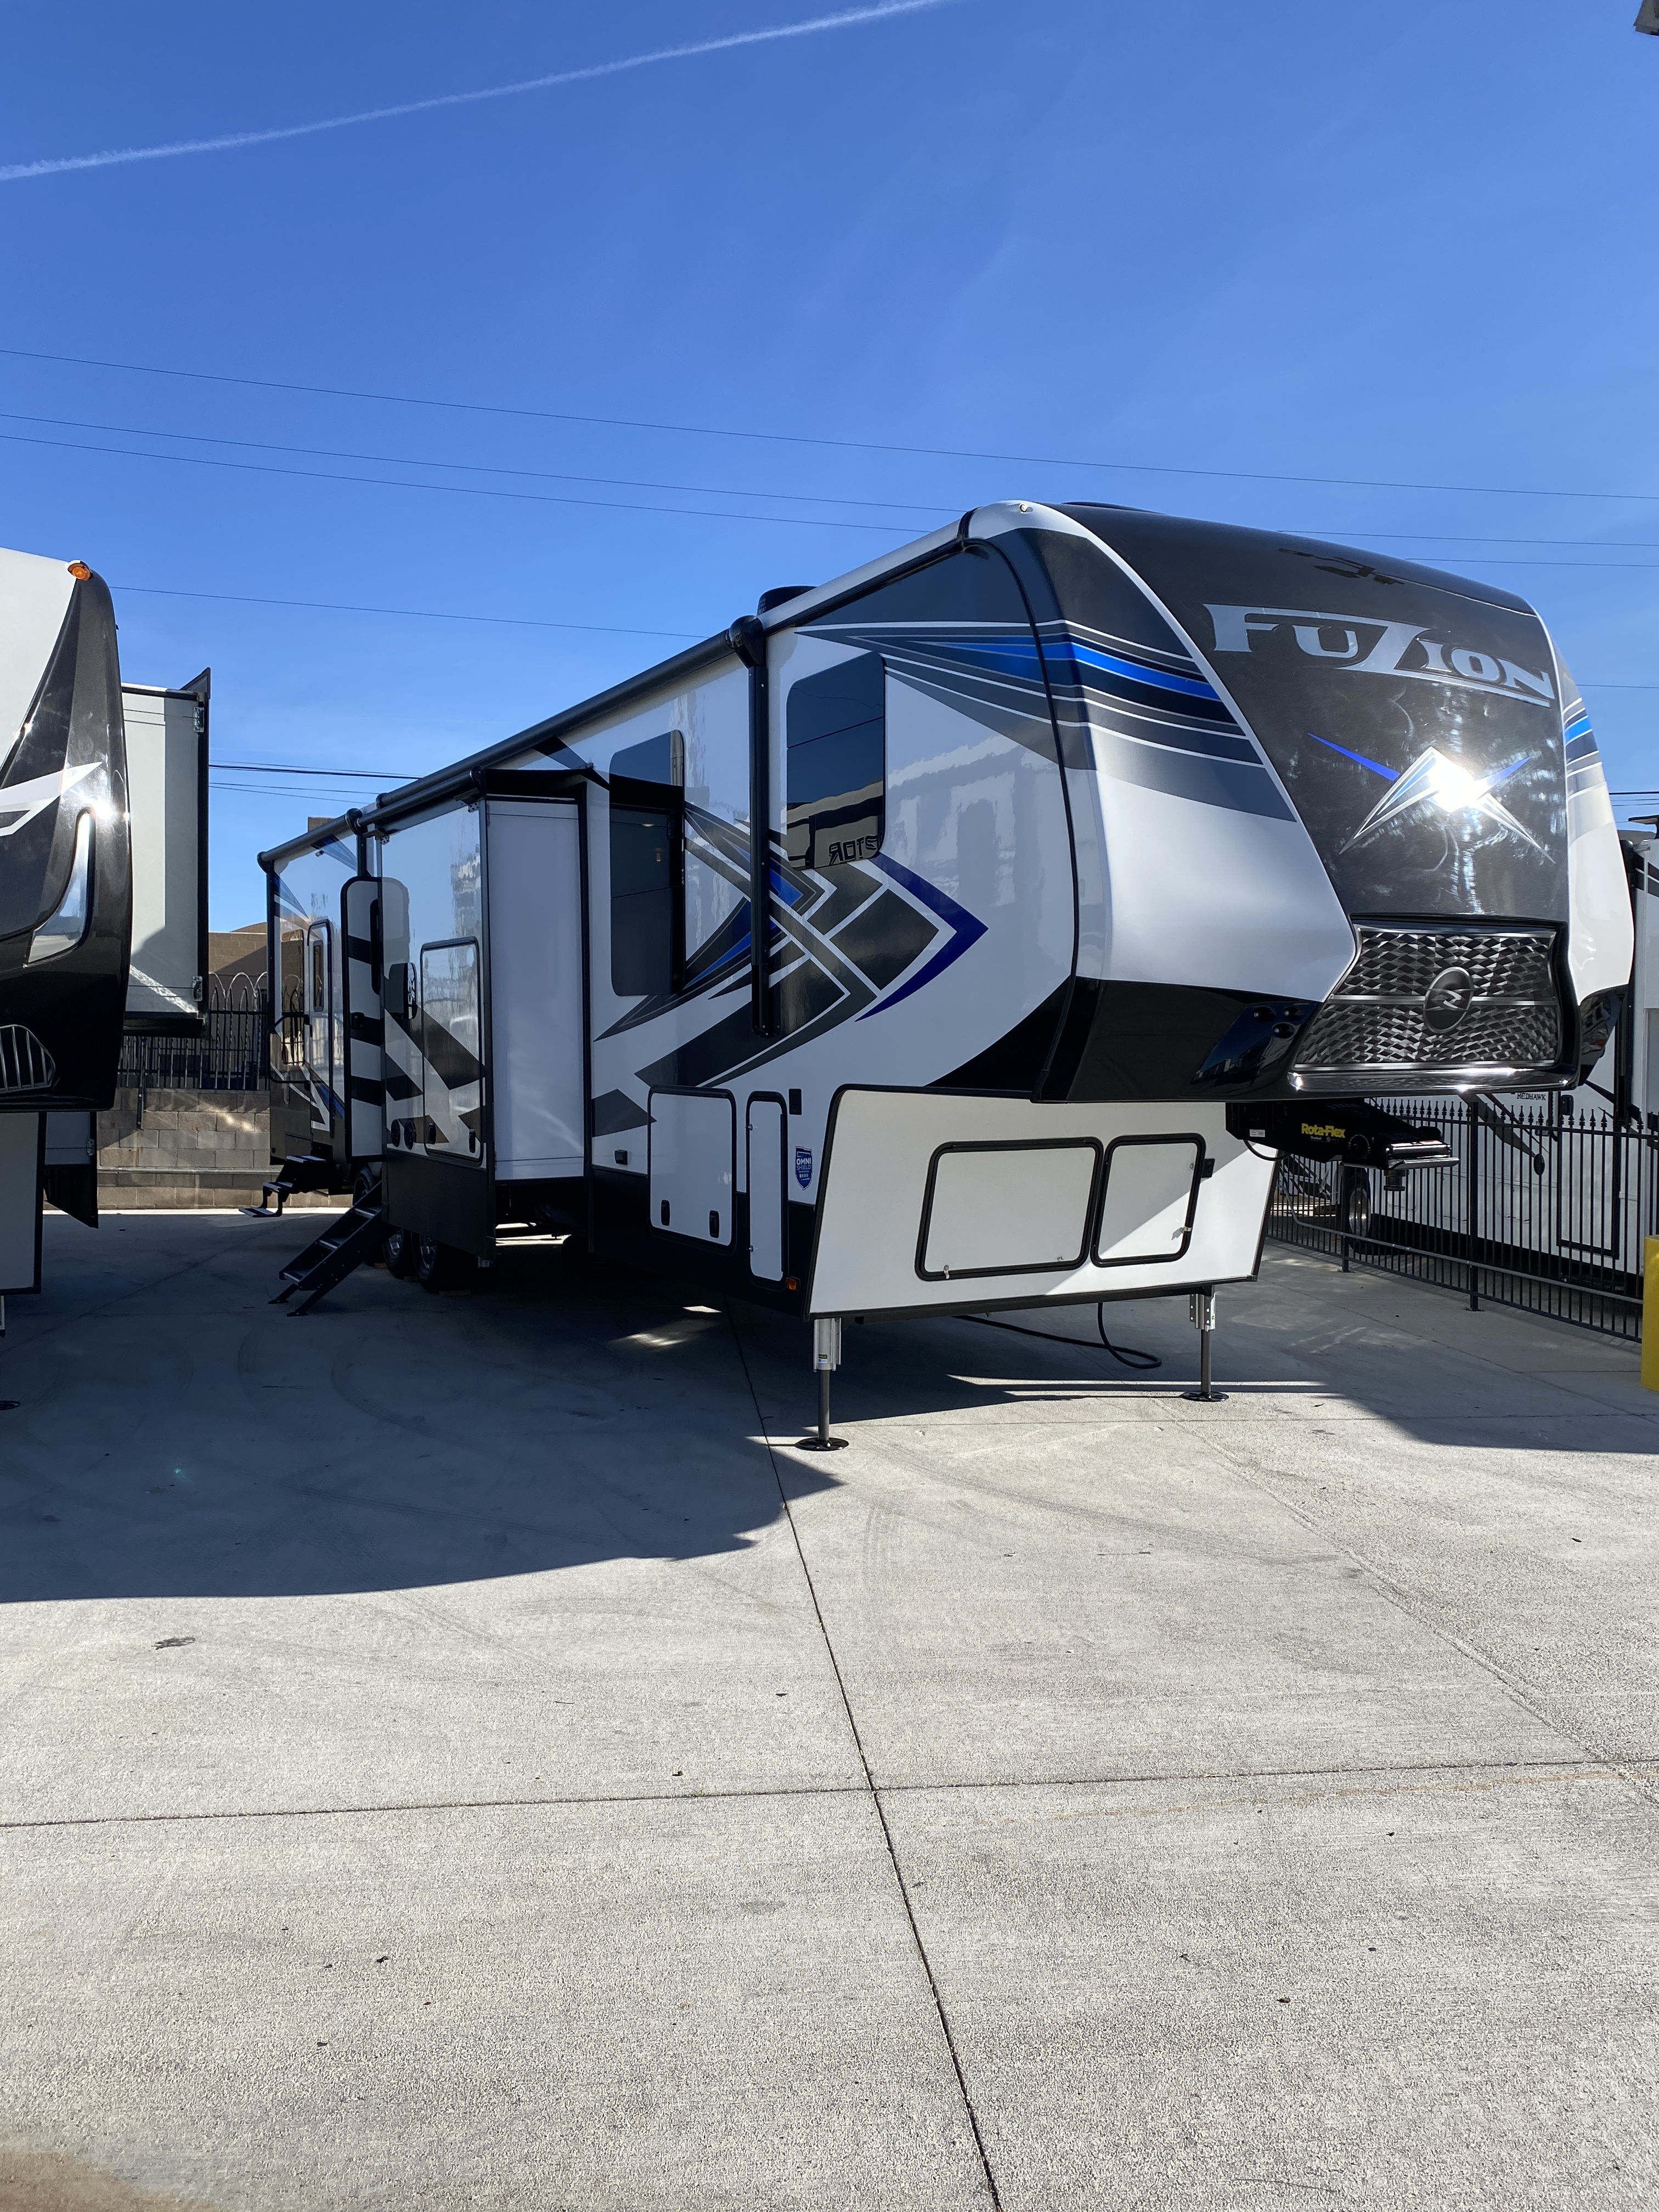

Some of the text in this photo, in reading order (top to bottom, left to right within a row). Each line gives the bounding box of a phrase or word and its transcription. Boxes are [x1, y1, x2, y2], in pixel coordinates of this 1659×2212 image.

[1203, 603, 1555, 708] FUZION
[1517, 1092, 1546, 1101] REDHAWK
[1301, 1123, 1346, 1138] Rota-Flex
[796, 1157, 811, 1165] OMNI
